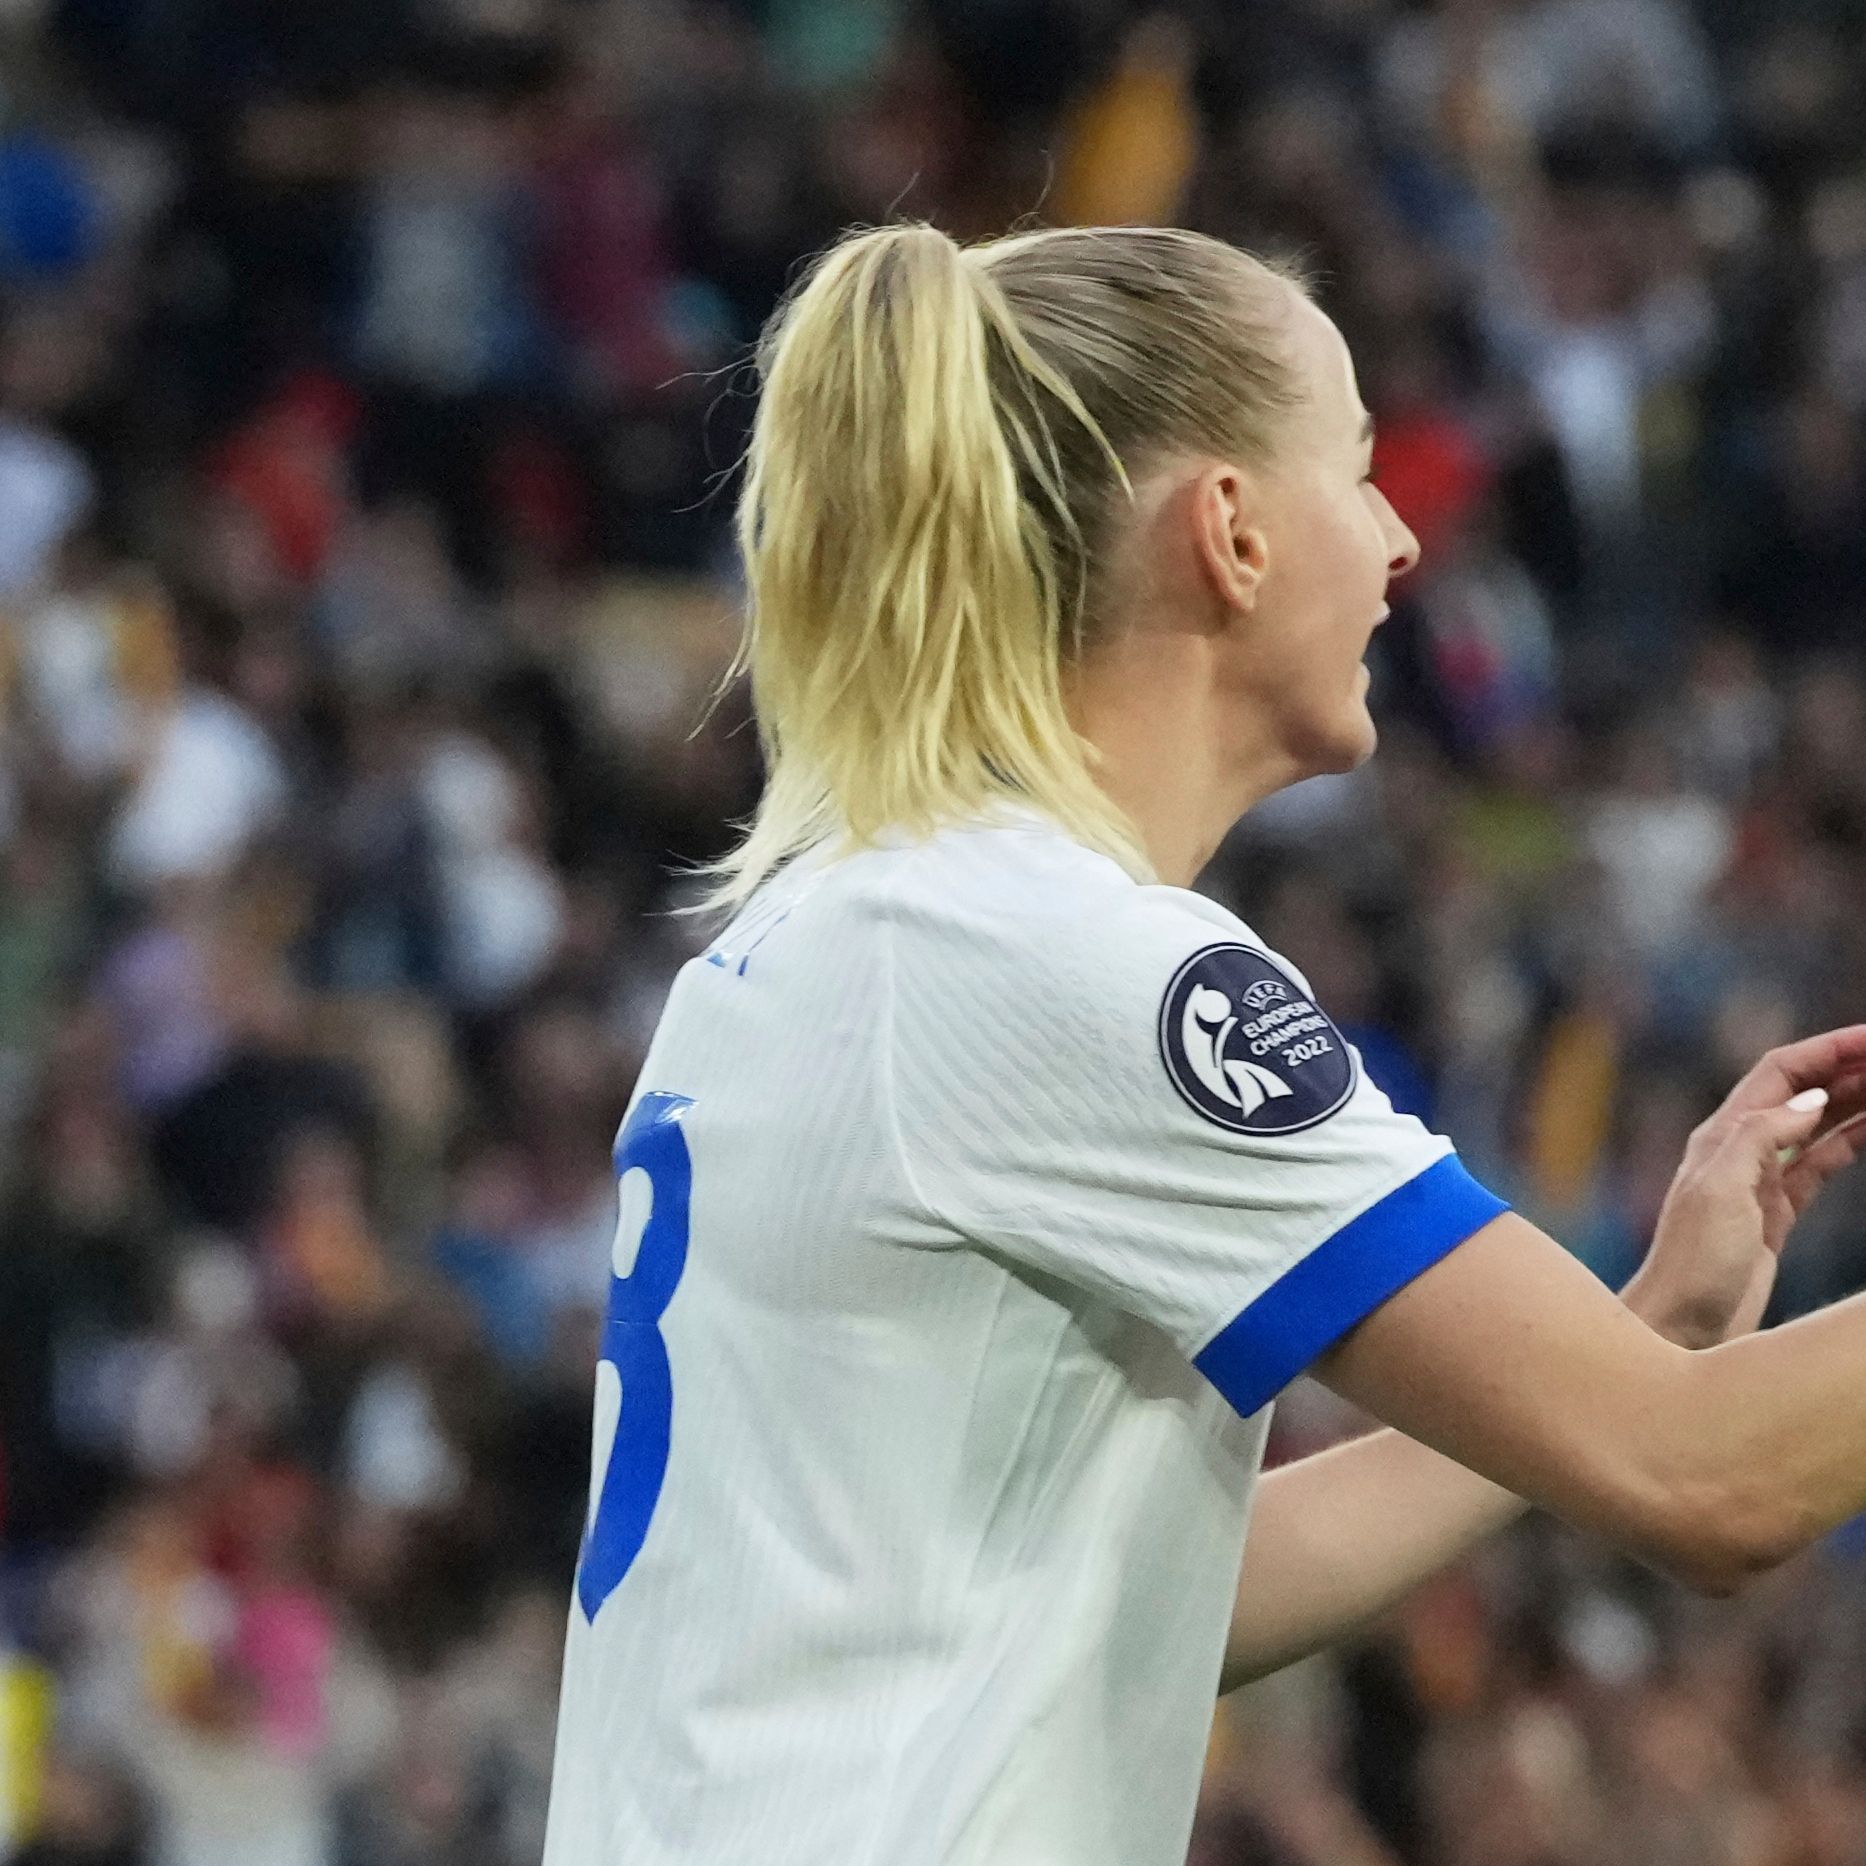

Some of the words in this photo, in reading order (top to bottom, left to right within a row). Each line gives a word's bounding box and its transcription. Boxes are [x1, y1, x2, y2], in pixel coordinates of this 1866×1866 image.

[1243, 981, 1288, 1010] UEFA
[1242, 1001, 1315, 1039] EUROPEAN
[1250, 1015, 1328, 1056] CHAMPIONS
[1282, 1036, 1333, 1067] 2022
